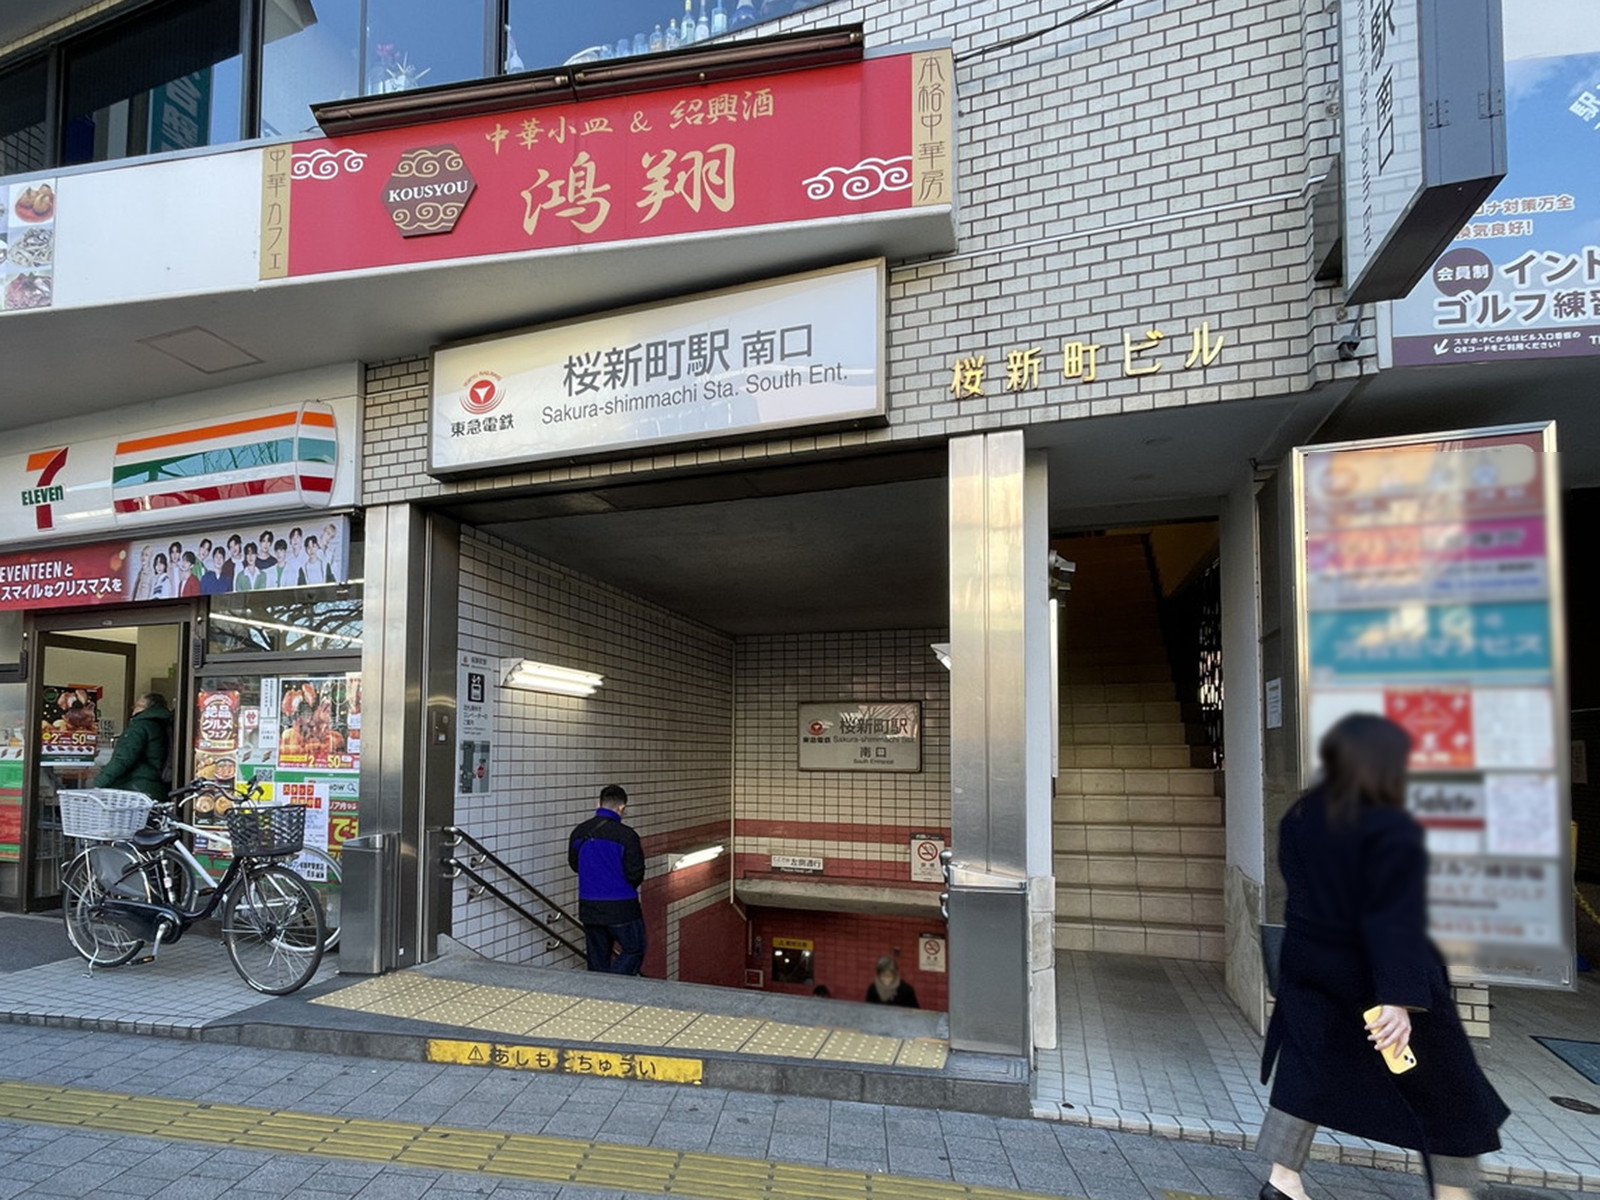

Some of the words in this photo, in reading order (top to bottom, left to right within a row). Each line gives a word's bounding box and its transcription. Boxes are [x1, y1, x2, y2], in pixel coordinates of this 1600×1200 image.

[485, 116, 613, 154] 中華小皿
[630, 110, 652, 133] &
[669, 88, 775, 128] 紹興酒
[918, 55, 946, 201] 本格中華房
[1376, 64, 1393, 176] 南口
[388, 180, 469, 203] KOUSYOU
[520, 143, 736, 236] 鴻翔
[1362, 127, 1370, 203] South
[1436, 264, 1490, 283] 会員制
[563, 328, 731, 397] 桜新町駅
[740, 323, 813, 368] 南口
[950, 321, 1225, 399] 桜新町ビル
[450, 413, 515, 437] 東急電鉄
[541, 383, 698, 425] Sakura-shimmachi
[703, 380, 739, 400] Sta.
[745, 368, 802, 394] South
[809, 362, 849, 385] Ent.
[26, 446, 69, 530] 7
[1, 577, 122, 600] スマイルなクリスマスを
[202, 720, 233, 730] グルメ
[840, 718, 908, 735] 桜新町駅
[860, 747, 887, 757] 南口
[493, 1048, 657, 1077] あしもちゅうい
